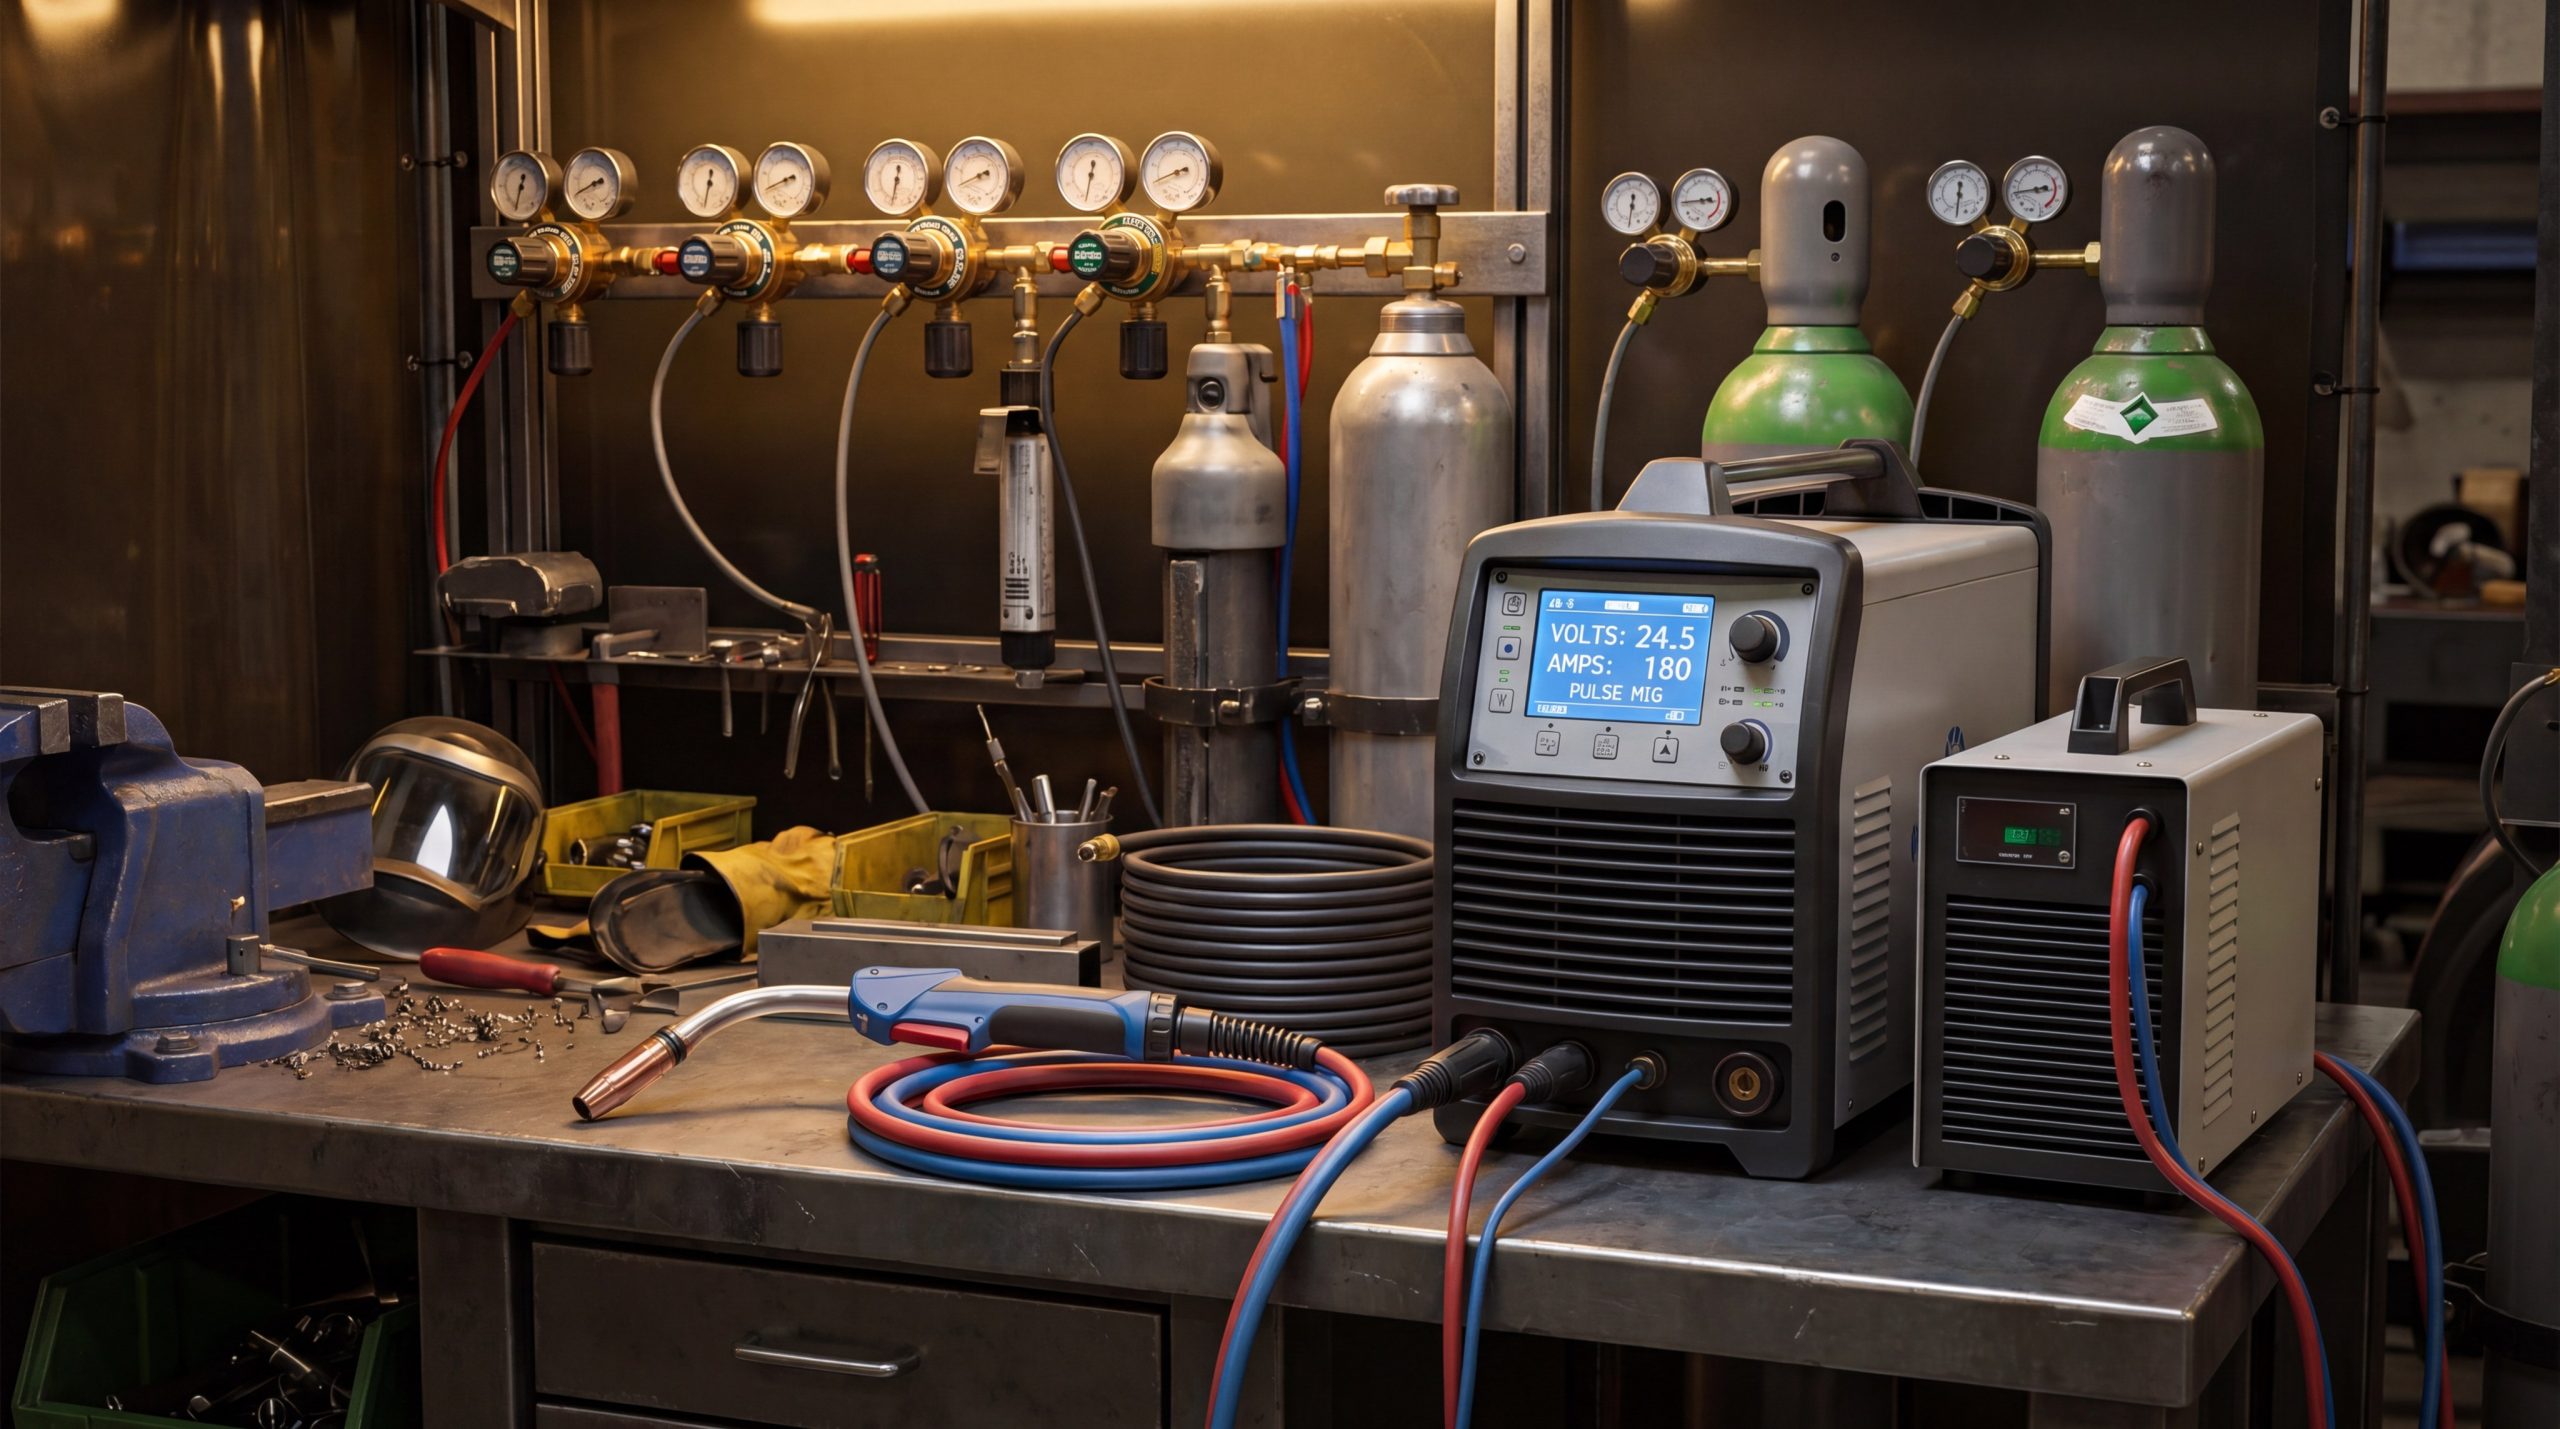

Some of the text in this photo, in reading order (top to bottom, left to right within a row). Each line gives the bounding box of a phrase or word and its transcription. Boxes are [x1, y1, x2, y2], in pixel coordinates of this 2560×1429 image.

[1551, 623, 1695, 650] VOLTS: 24.5
[1546, 653, 1692, 681] AMPS: 180
[1569, 682, 1663, 703] PULSE MIG
